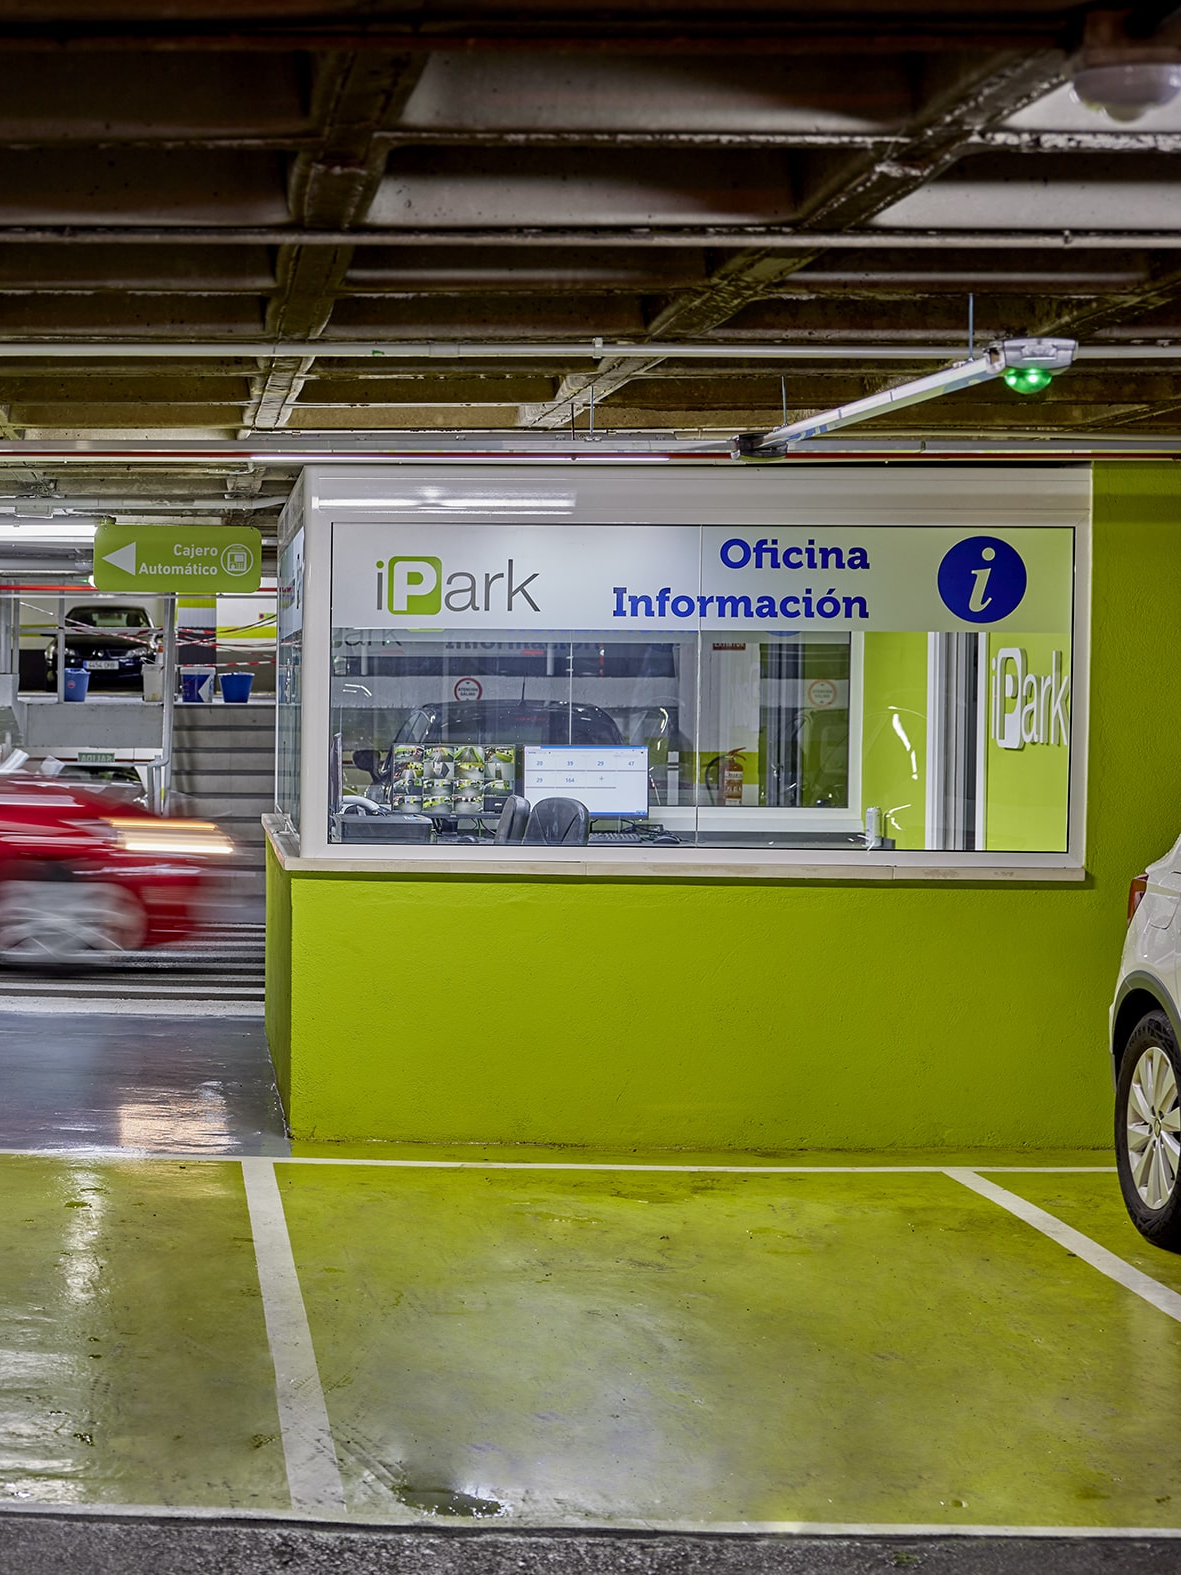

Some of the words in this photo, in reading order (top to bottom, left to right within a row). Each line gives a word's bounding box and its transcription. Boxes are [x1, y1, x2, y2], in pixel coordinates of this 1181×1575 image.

[173, 543, 218, 559] Cajero
[720, 538, 870, 570] Oficina
[139, 561, 218, 576] Automático
[375, 556, 541, 615] iPark
[612, 587, 870, 619] Información
